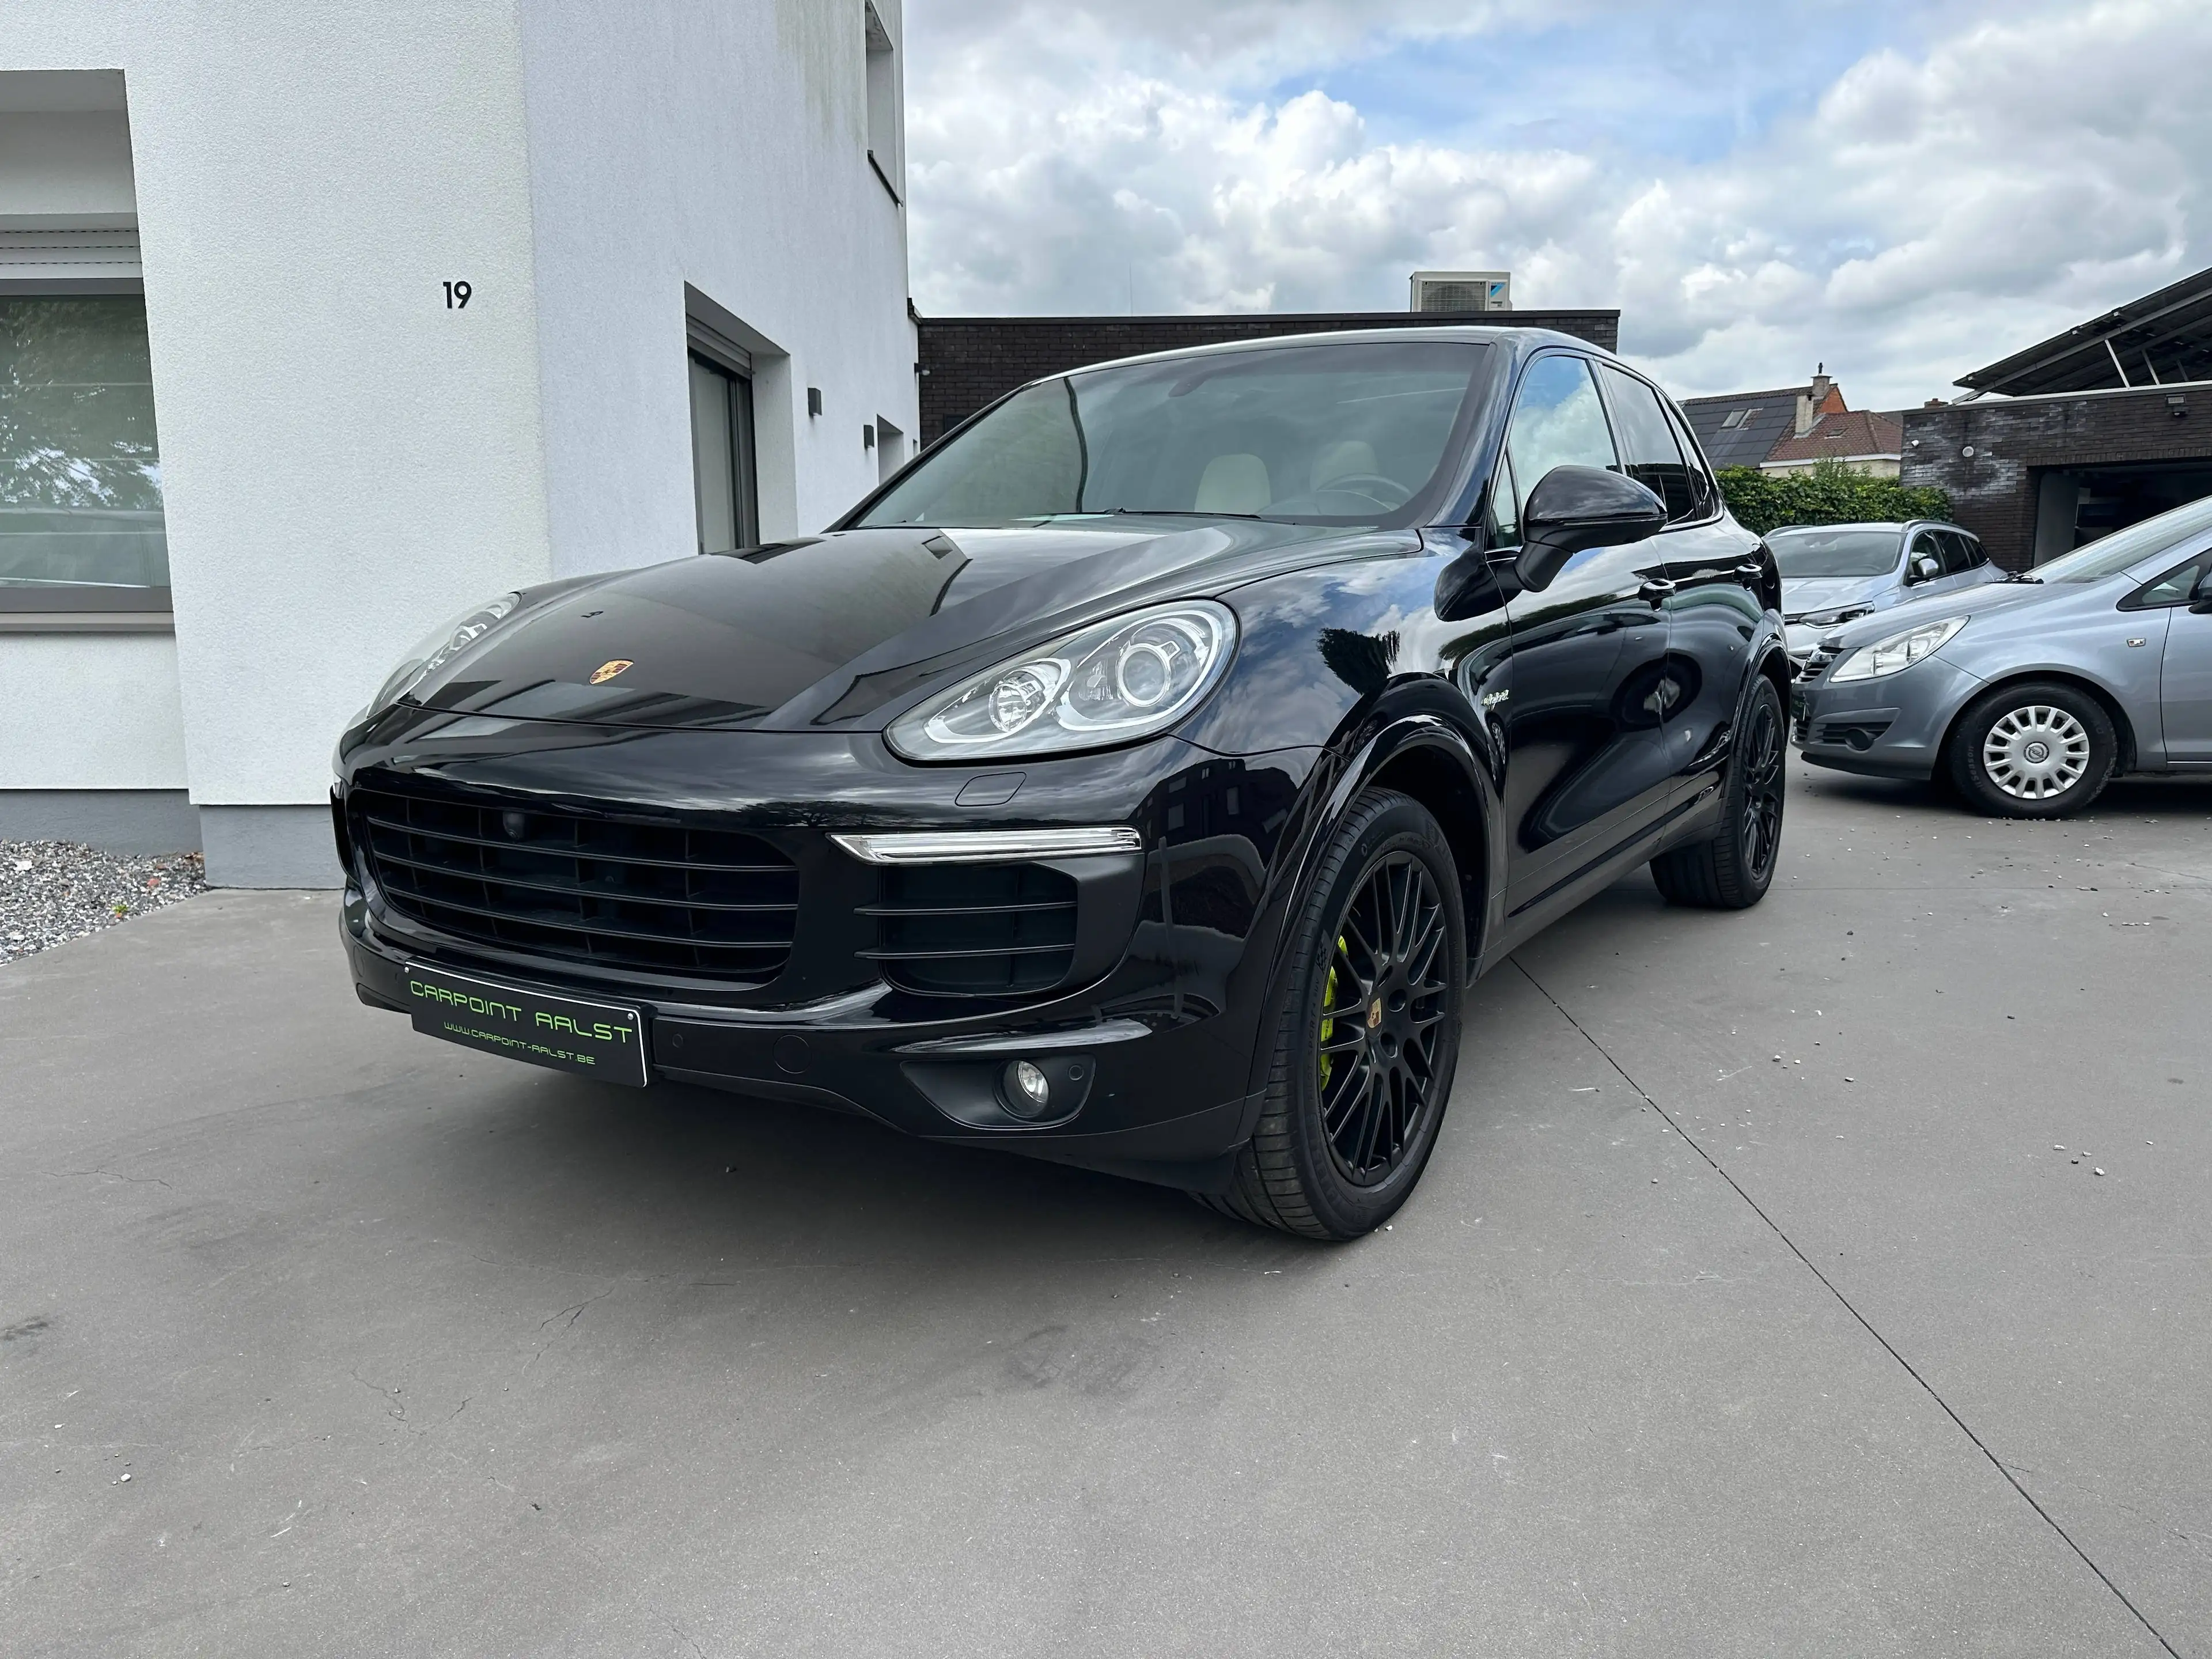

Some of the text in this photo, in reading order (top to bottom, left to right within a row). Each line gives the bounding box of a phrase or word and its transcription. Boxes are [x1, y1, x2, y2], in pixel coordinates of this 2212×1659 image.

[443, 281, 472, 309] 19
[410, 980, 632, 1043] CARPOINT AALST
[1308, 1010, 1317, 1056] SPORT
